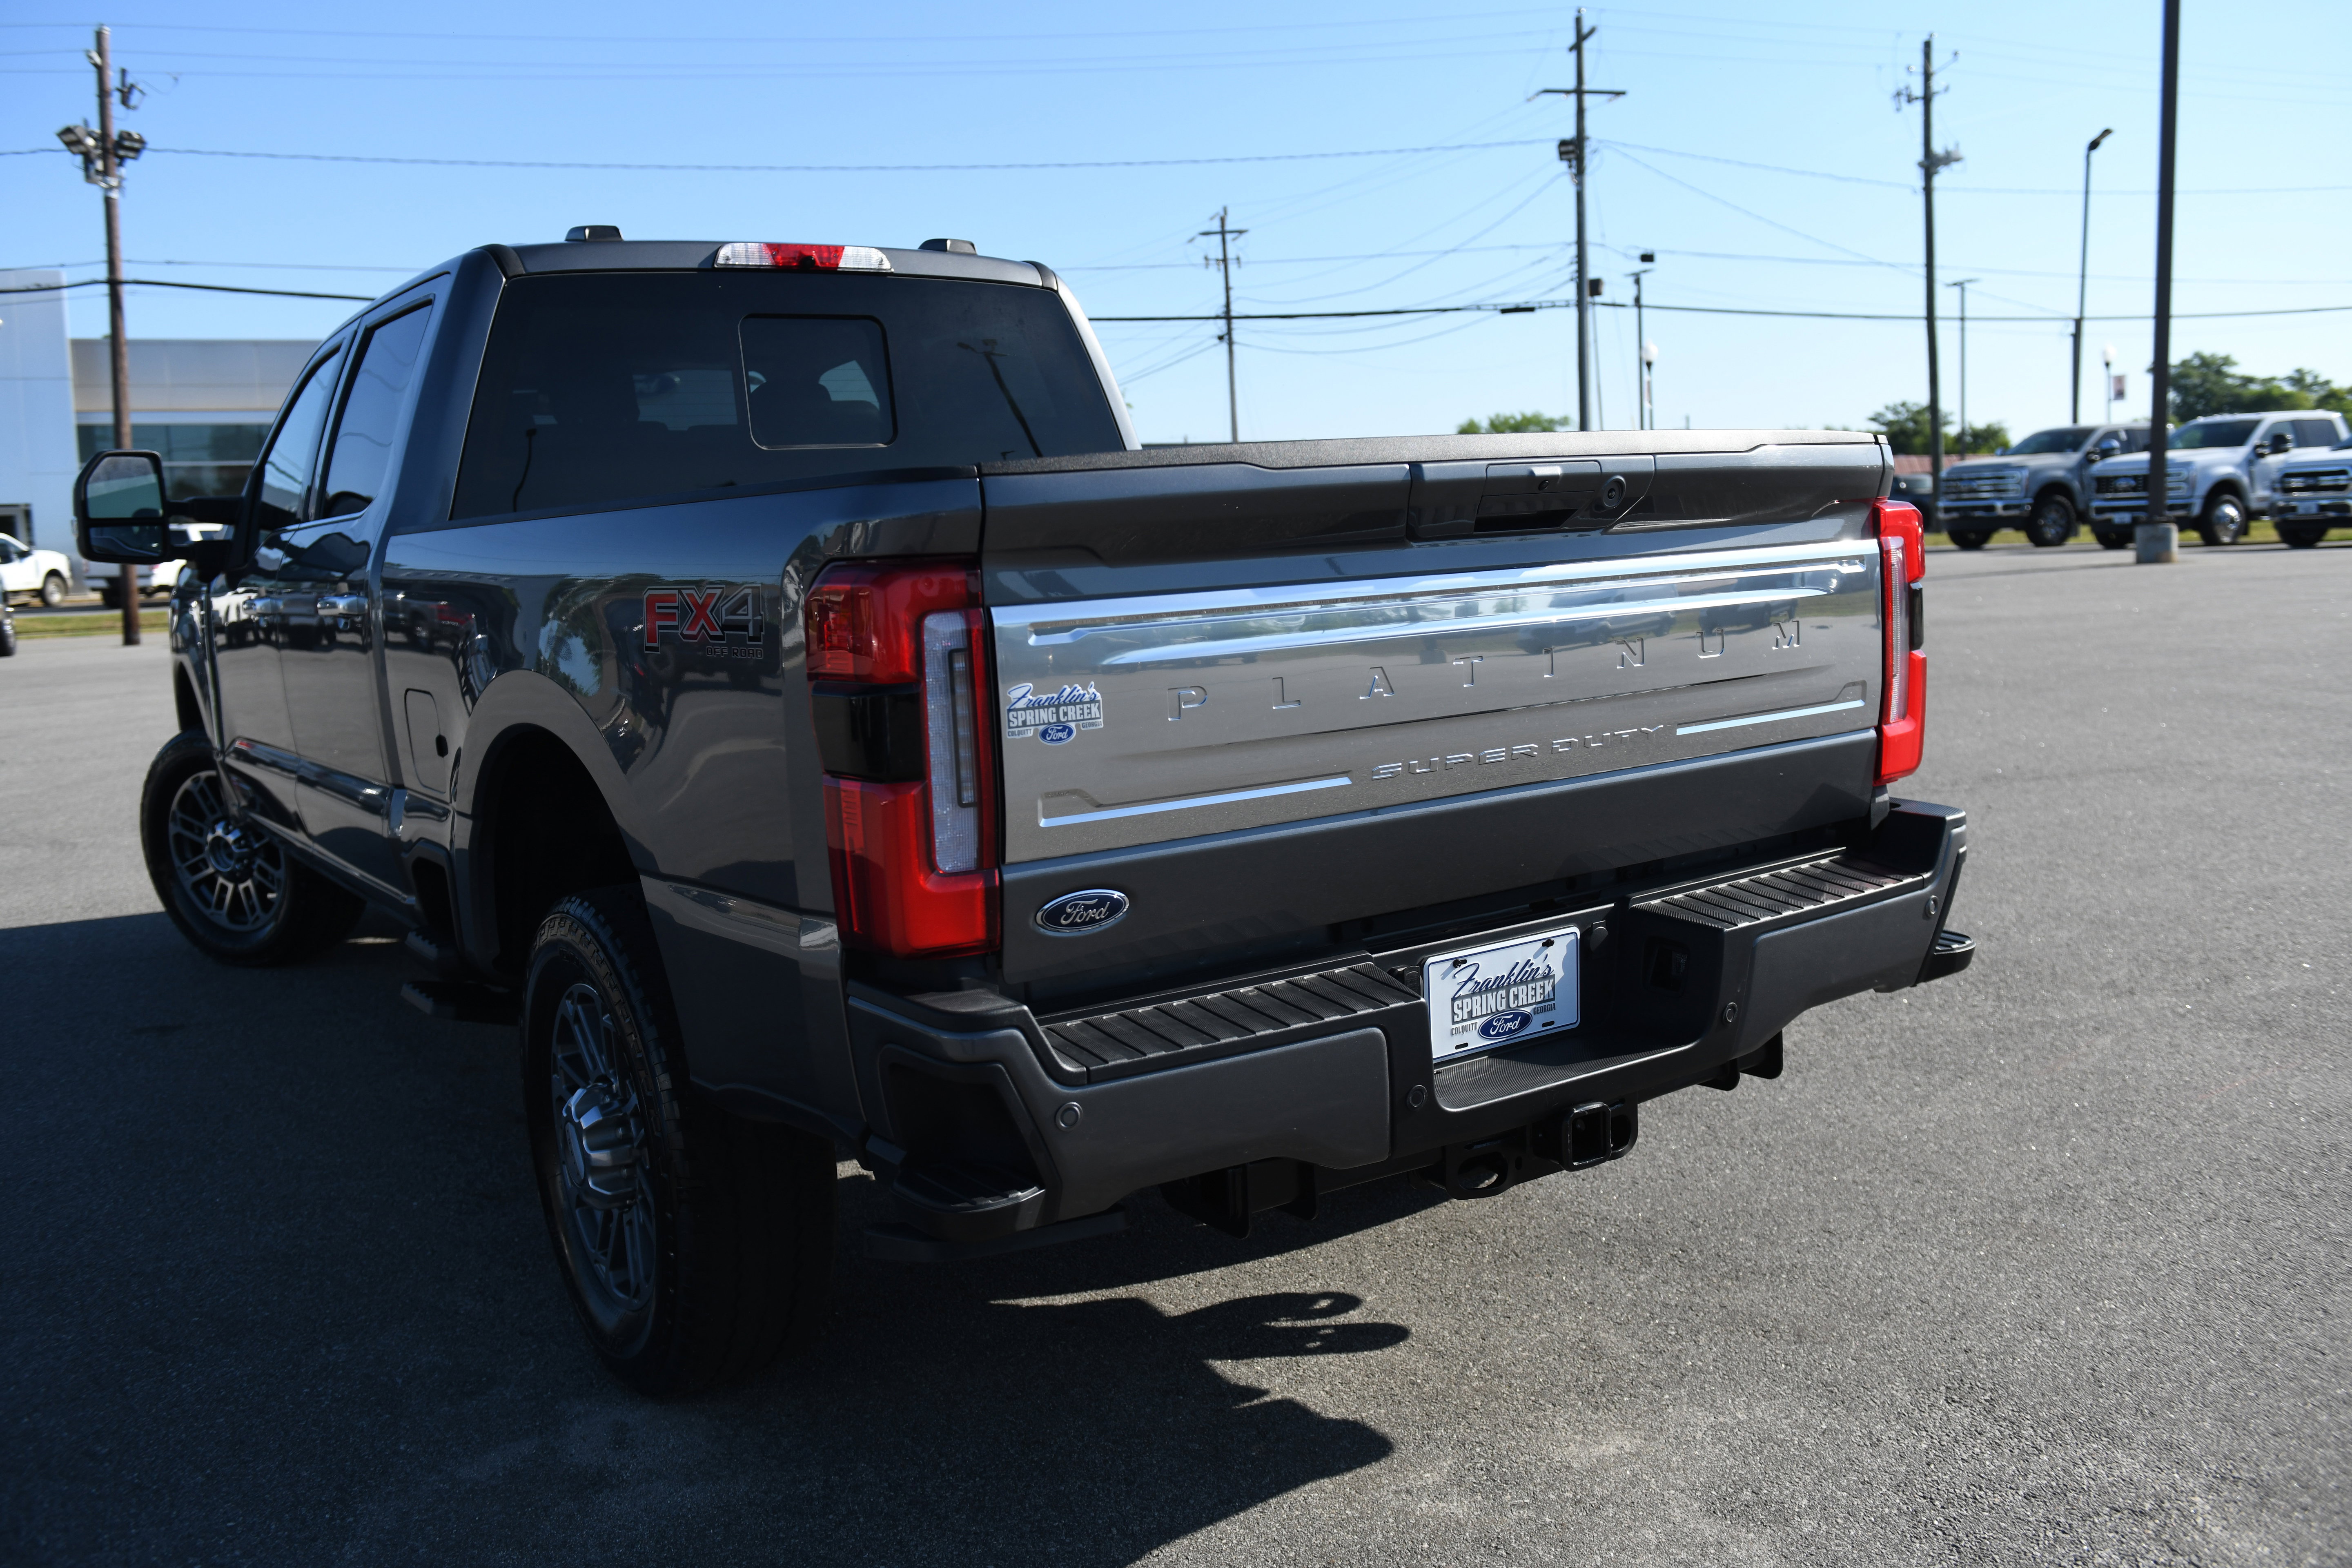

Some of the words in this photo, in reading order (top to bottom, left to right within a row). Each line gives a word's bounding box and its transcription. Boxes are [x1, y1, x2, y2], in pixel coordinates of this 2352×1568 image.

[643, 584, 765, 654] FX4
[706, 646, 728, 657] OFF
[732, 647, 764, 659] ROAD
[1167, 619, 1801, 722] PLATINUM
[1007, 684, 1099, 710] Franklin's
[1009, 707, 1057, 727] SPRING
[1059, 703, 1100, 722] CREEK
[1007, 728, 1032, 737] COLQUITT
[1046, 726, 1069, 741] Ford
[1370, 744, 1539, 781] SUPER
[1551, 724, 1664, 754] DUTY
[1060, 898, 1110, 925] Ford
[1452, 953, 1555, 1000] Franklin's
[1453, 991, 1506, 1022] SPRING
[1509, 978, 1555, 1009] CREEK
[1533, 1002, 1556, 1016] GEORGIA
[1451, 1022, 1478, 1036] COLQUITT
[1490, 1014, 1521, 1036] Ford
